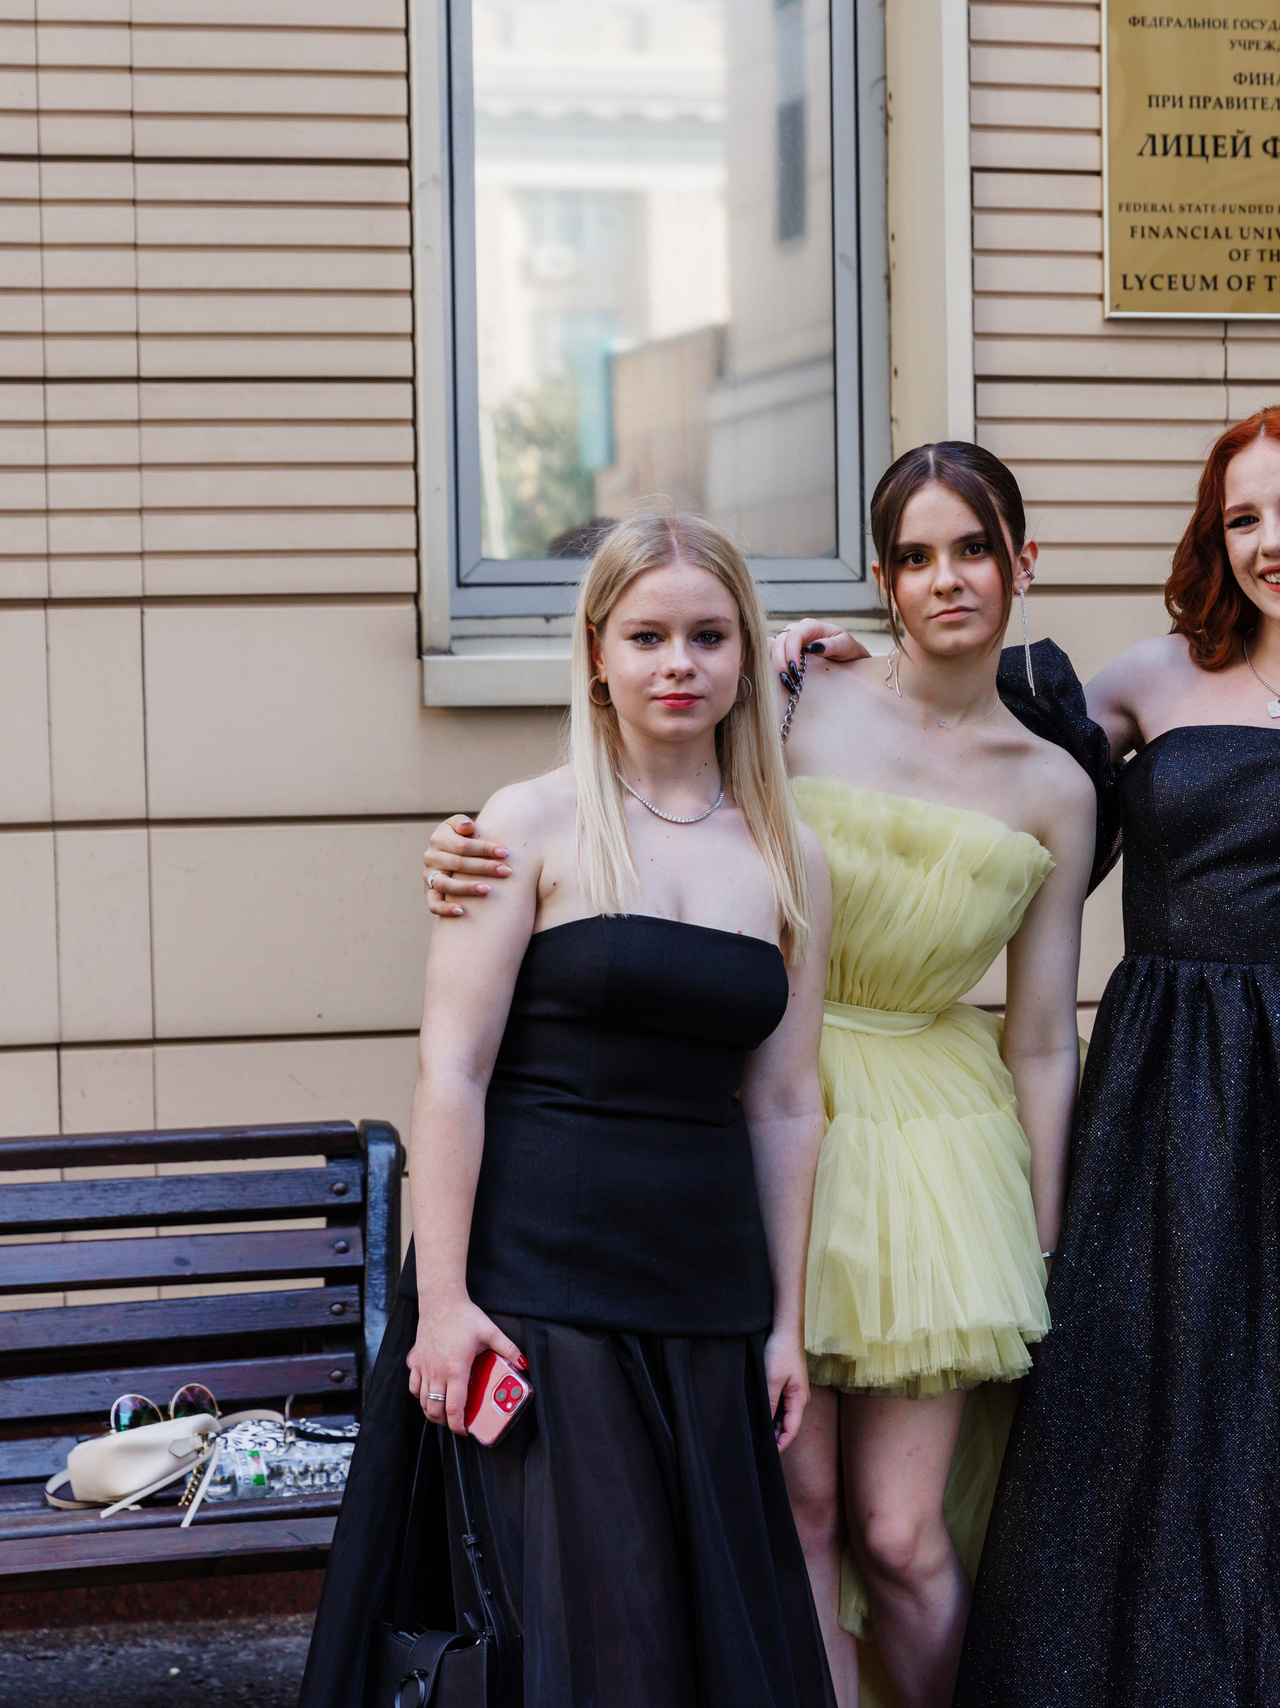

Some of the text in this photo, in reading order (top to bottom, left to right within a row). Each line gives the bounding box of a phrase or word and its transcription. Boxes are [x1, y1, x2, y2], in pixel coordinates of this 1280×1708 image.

[1128, 16, 1229, 30] ФЕДЕРАЛЬНОЕ
[1147, 95, 1186, 109] ПРИ
[1136, 129, 1252, 161] ЛИЦЕЙ
[1118, 202, 1175, 213] FEDERAL
[1179, 203, 1274, 215] STATE-FUNDED
[1130, 225, 1233, 241] FINANCIAL
[1229, 249, 1253, 262] OF
[1122, 274, 1218, 292] LYCEUM
[1227, 275, 1258, 292] OF
